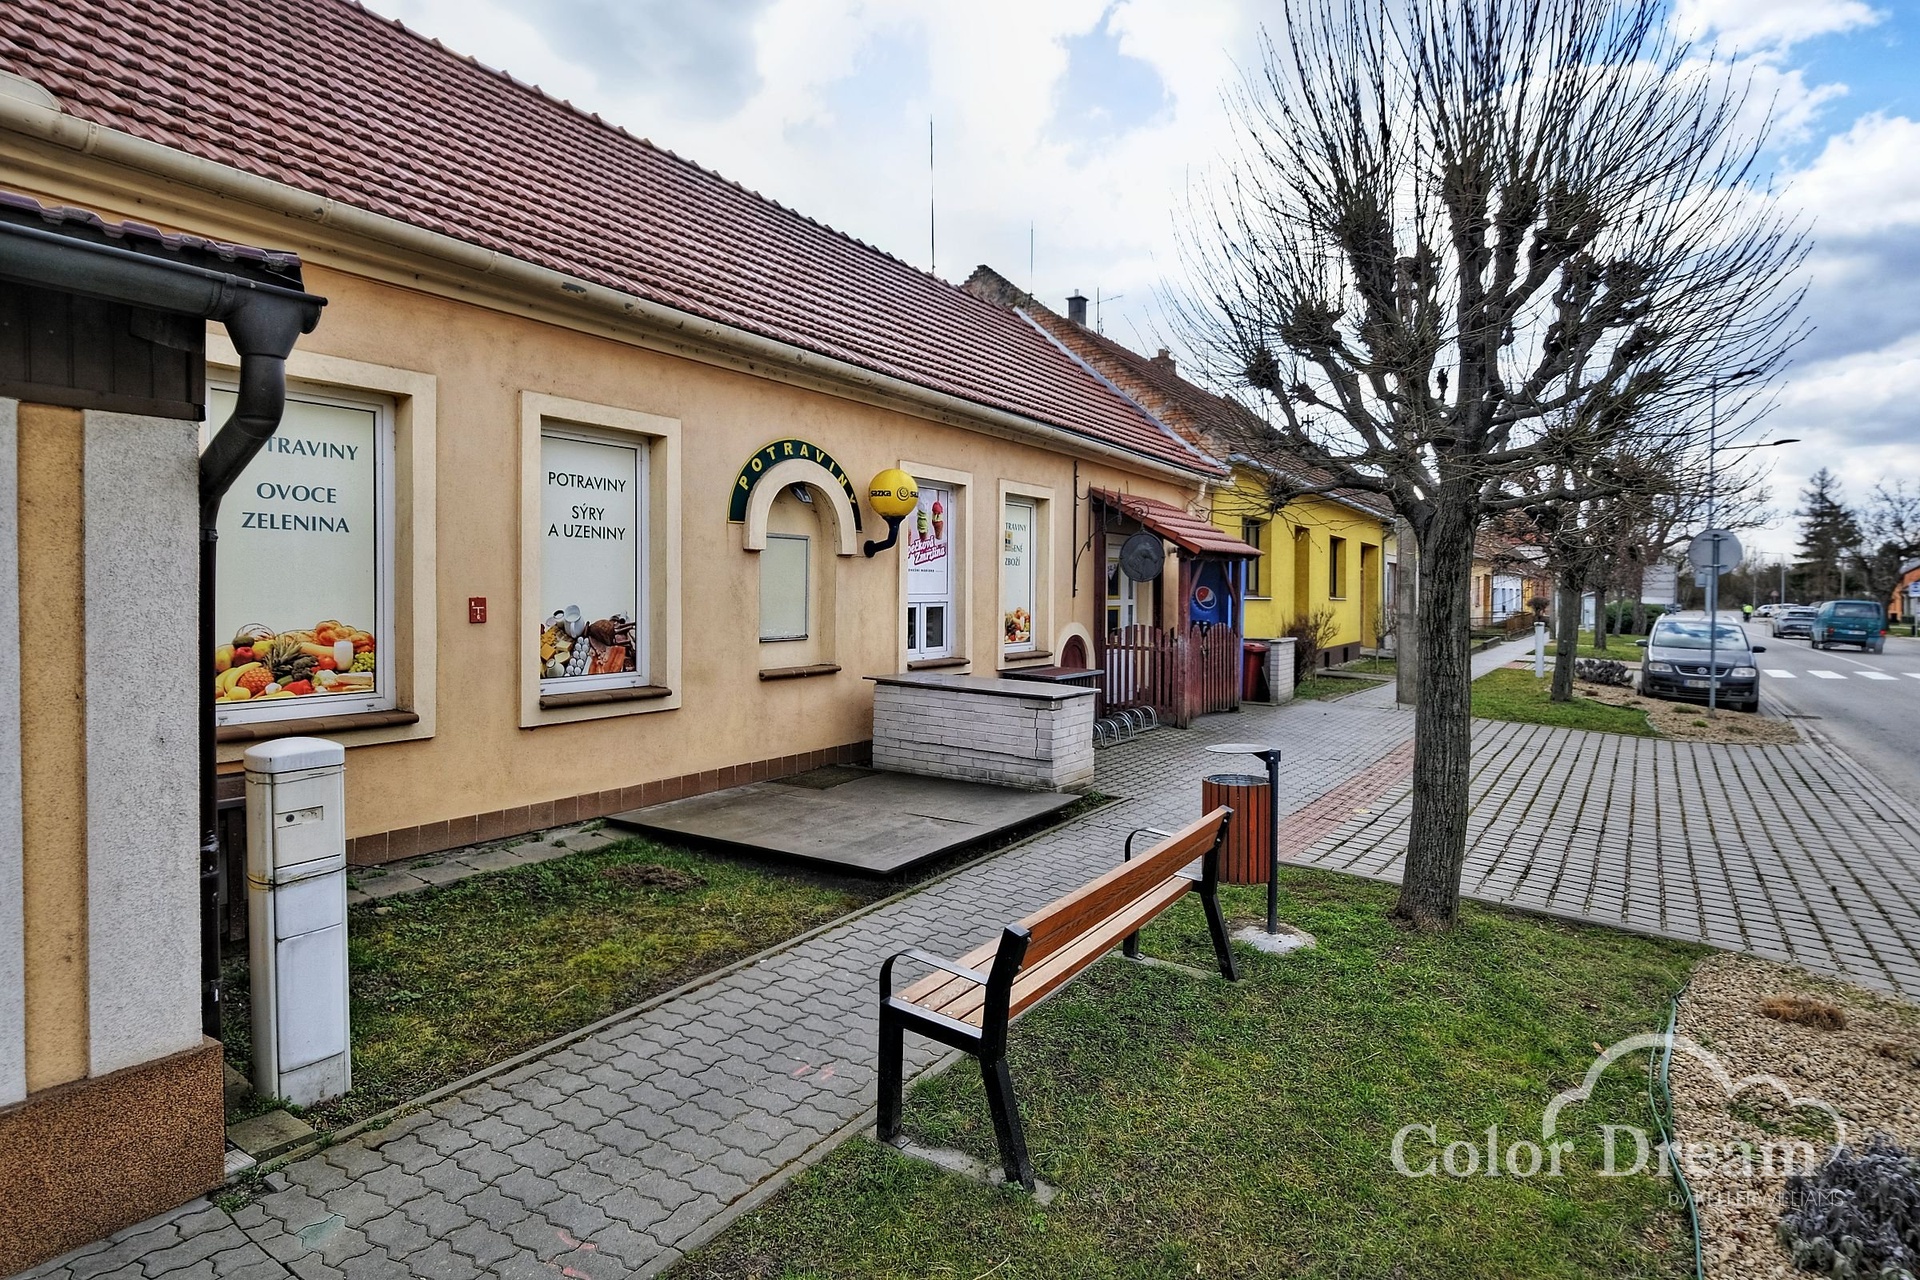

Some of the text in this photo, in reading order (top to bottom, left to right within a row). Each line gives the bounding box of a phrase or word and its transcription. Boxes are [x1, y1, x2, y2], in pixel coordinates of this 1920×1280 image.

[266, 436, 358, 460] TRAVINY
[548, 471, 626, 493] POTRAVINY
[738, 442, 857, 504] POTRAVINY
[256, 482, 337, 504] OVOCE
[241, 511, 350, 533] ZELENINA
[571, 502, 605, 521] SÝRY
[547, 523, 626, 541] A UZENINY
[1005, 521, 1028, 532] TRAVINY
